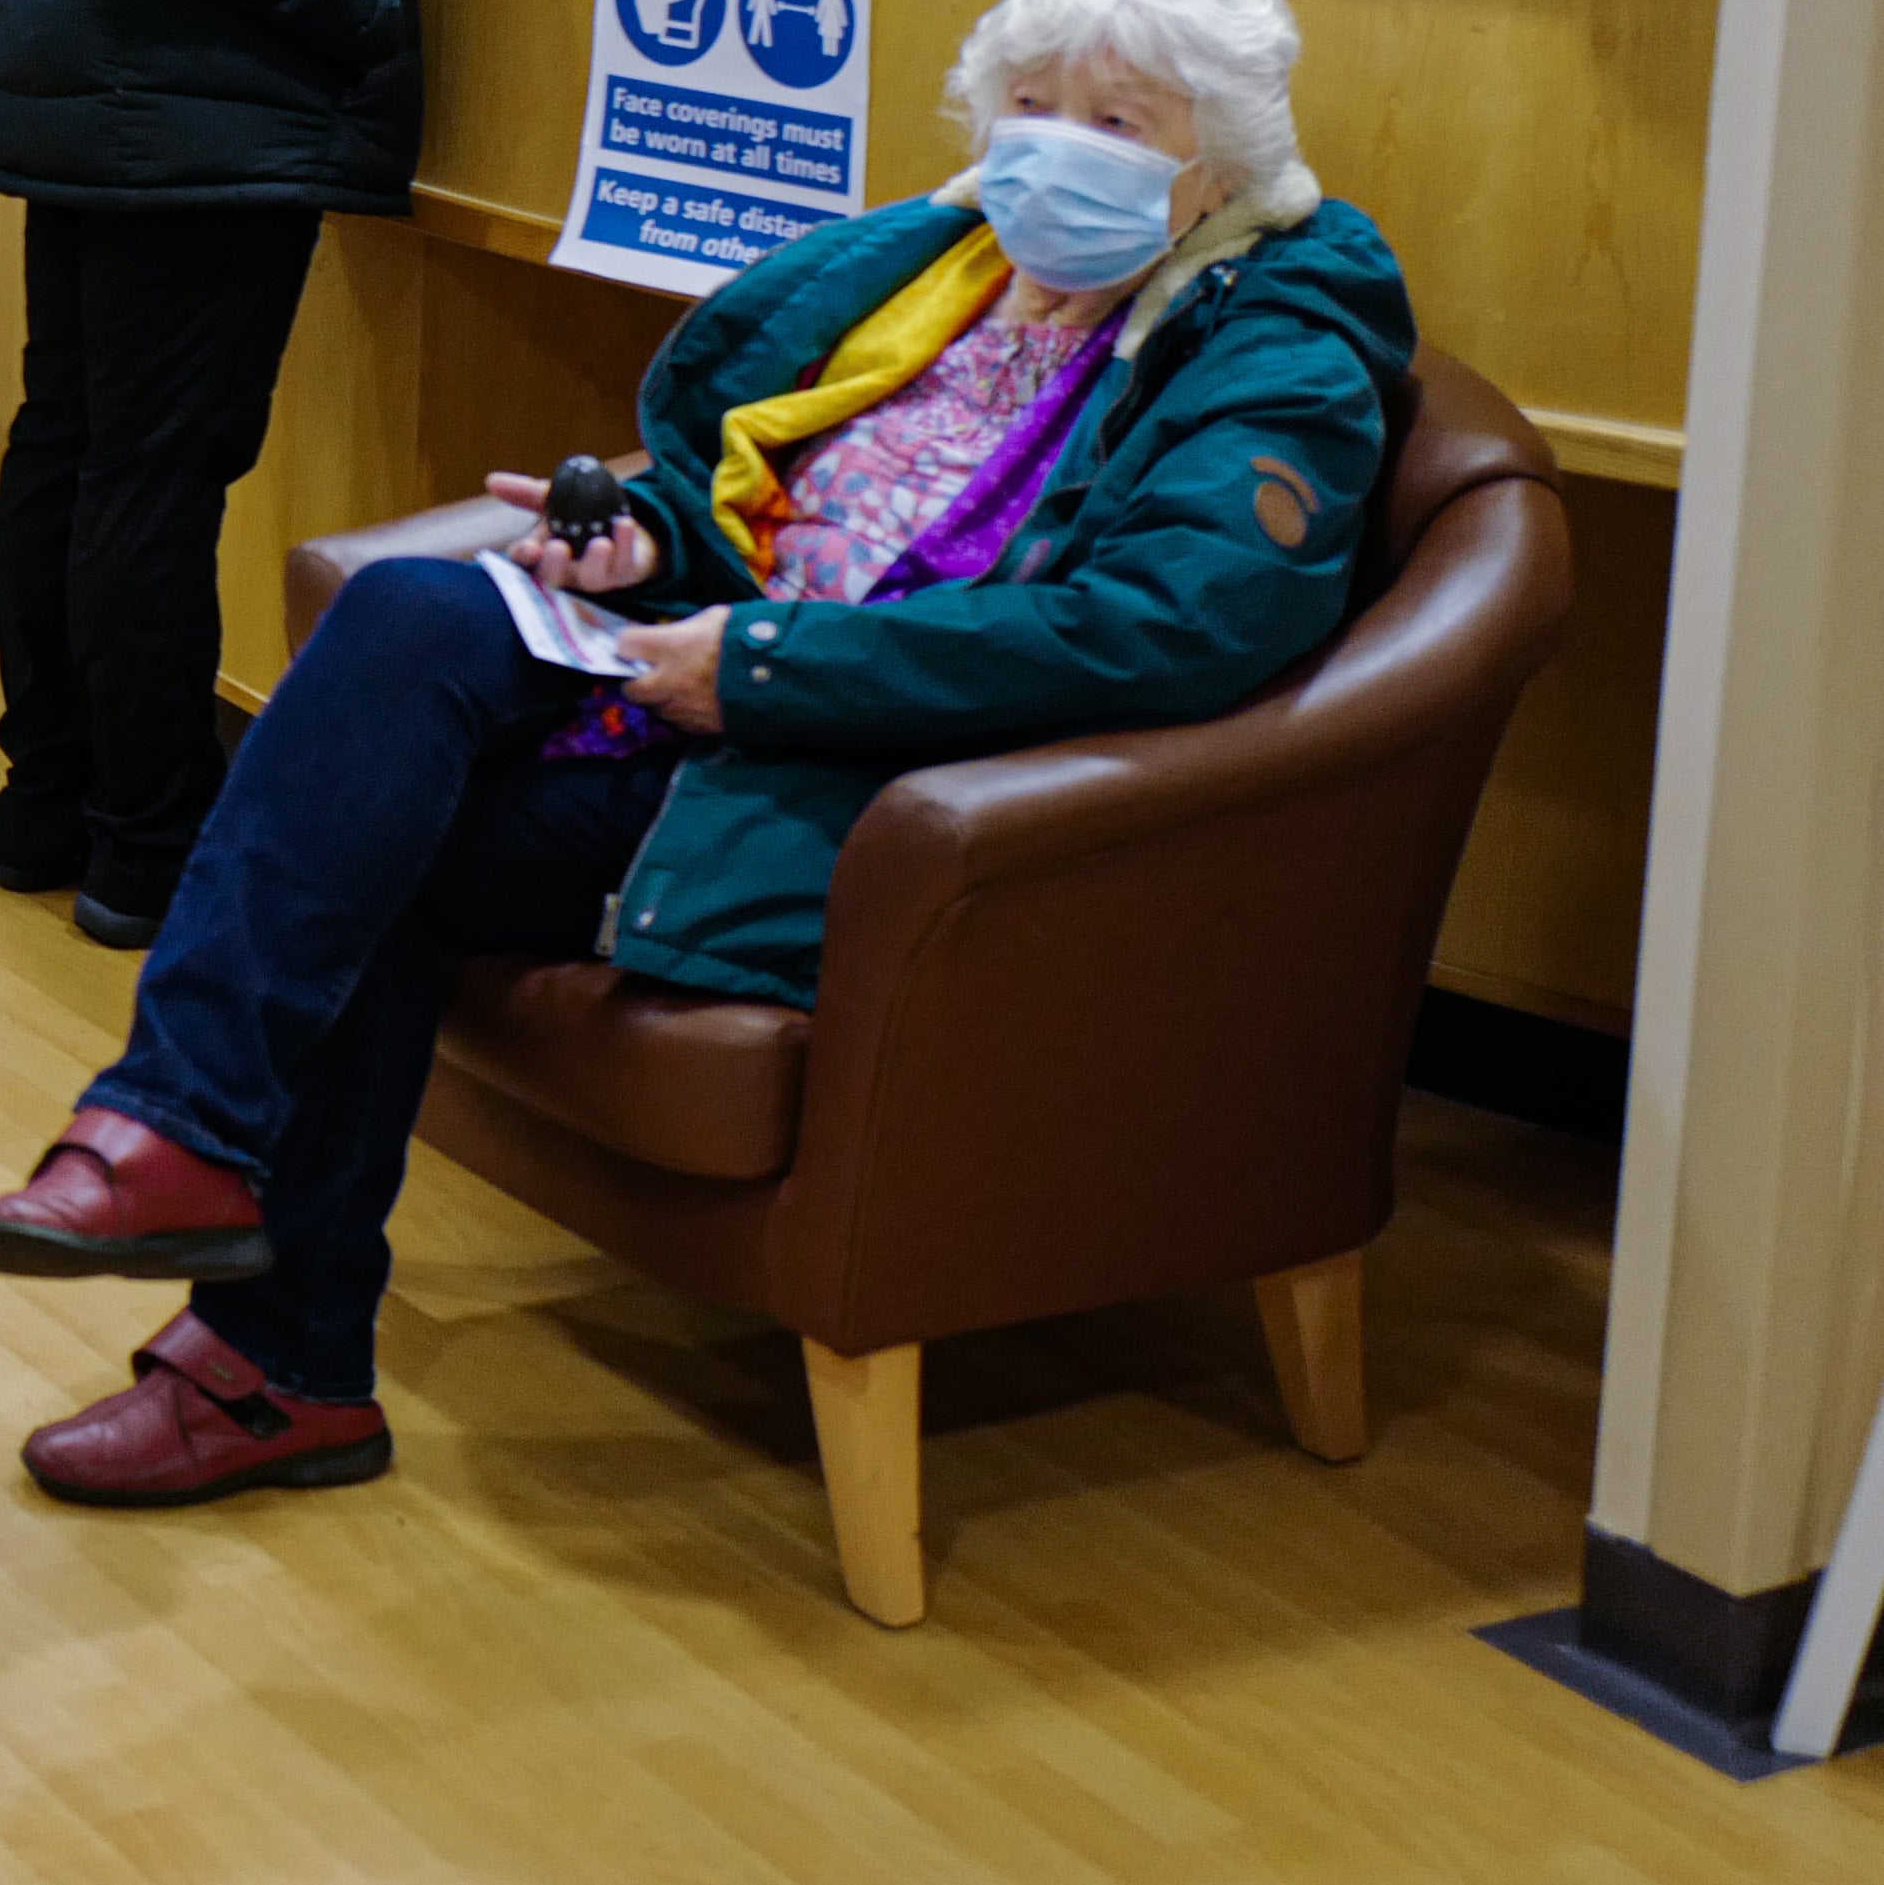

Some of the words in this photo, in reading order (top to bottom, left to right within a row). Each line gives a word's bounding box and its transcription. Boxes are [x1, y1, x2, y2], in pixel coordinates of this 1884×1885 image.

[609, 117, 640, 145] be
[644, 129, 707, 158] worn
[711, 141, 738, 164] at
[740, 145, 770, 170] all
[776, 150, 841, 184] times
[613, 87, 663, 117] Face
[666, 101, 778, 142] coverings
[782, 122, 844, 151] must
[596, 179, 659, 215] Keep
[661, 195, 679, 216] a
[682, 198, 735, 226] safe
[738, 206, 815, 241] distan
[639, 219, 699, 253] from
[701, 235, 769, 265] othe
